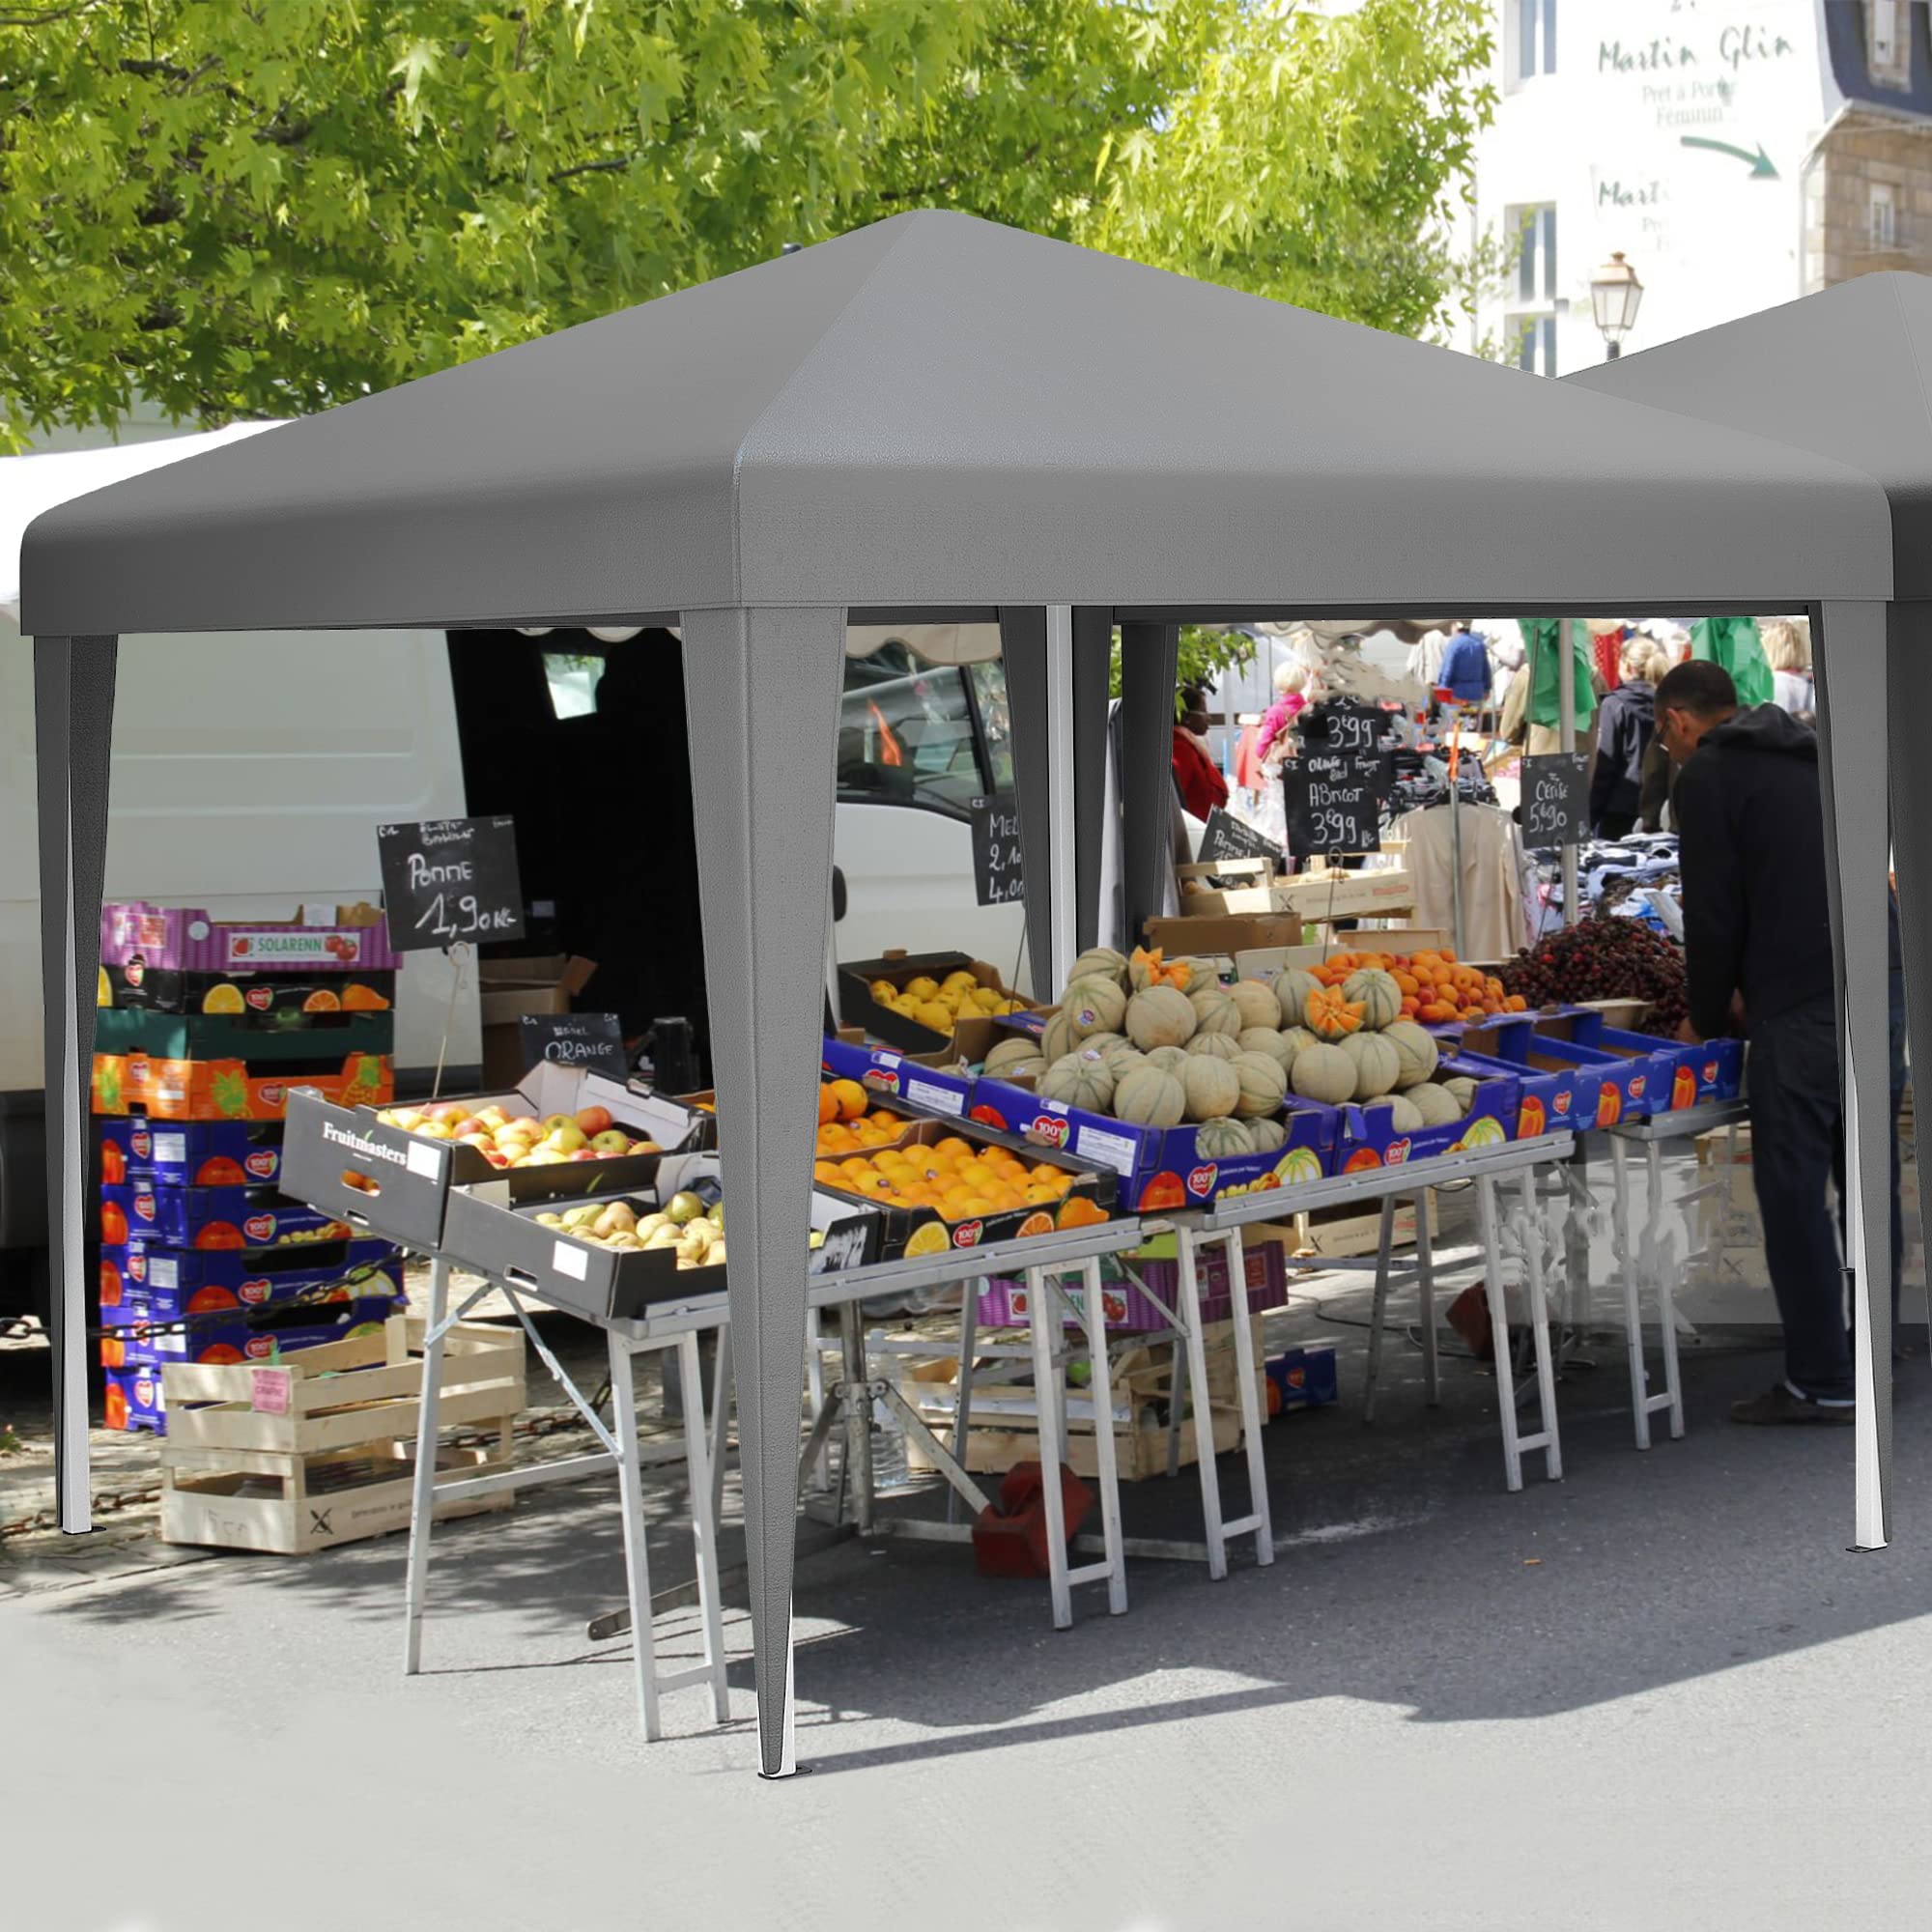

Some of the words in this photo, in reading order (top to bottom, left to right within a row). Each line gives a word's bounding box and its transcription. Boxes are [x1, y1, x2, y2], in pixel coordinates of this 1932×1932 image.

[1598, 35, 1697, 73] Martin
[1719, 23, 1792, 71] Glin
[258, 937, 322, 952] SOLARENN
[323, 1122, 407, 1166] Fruitmasters
